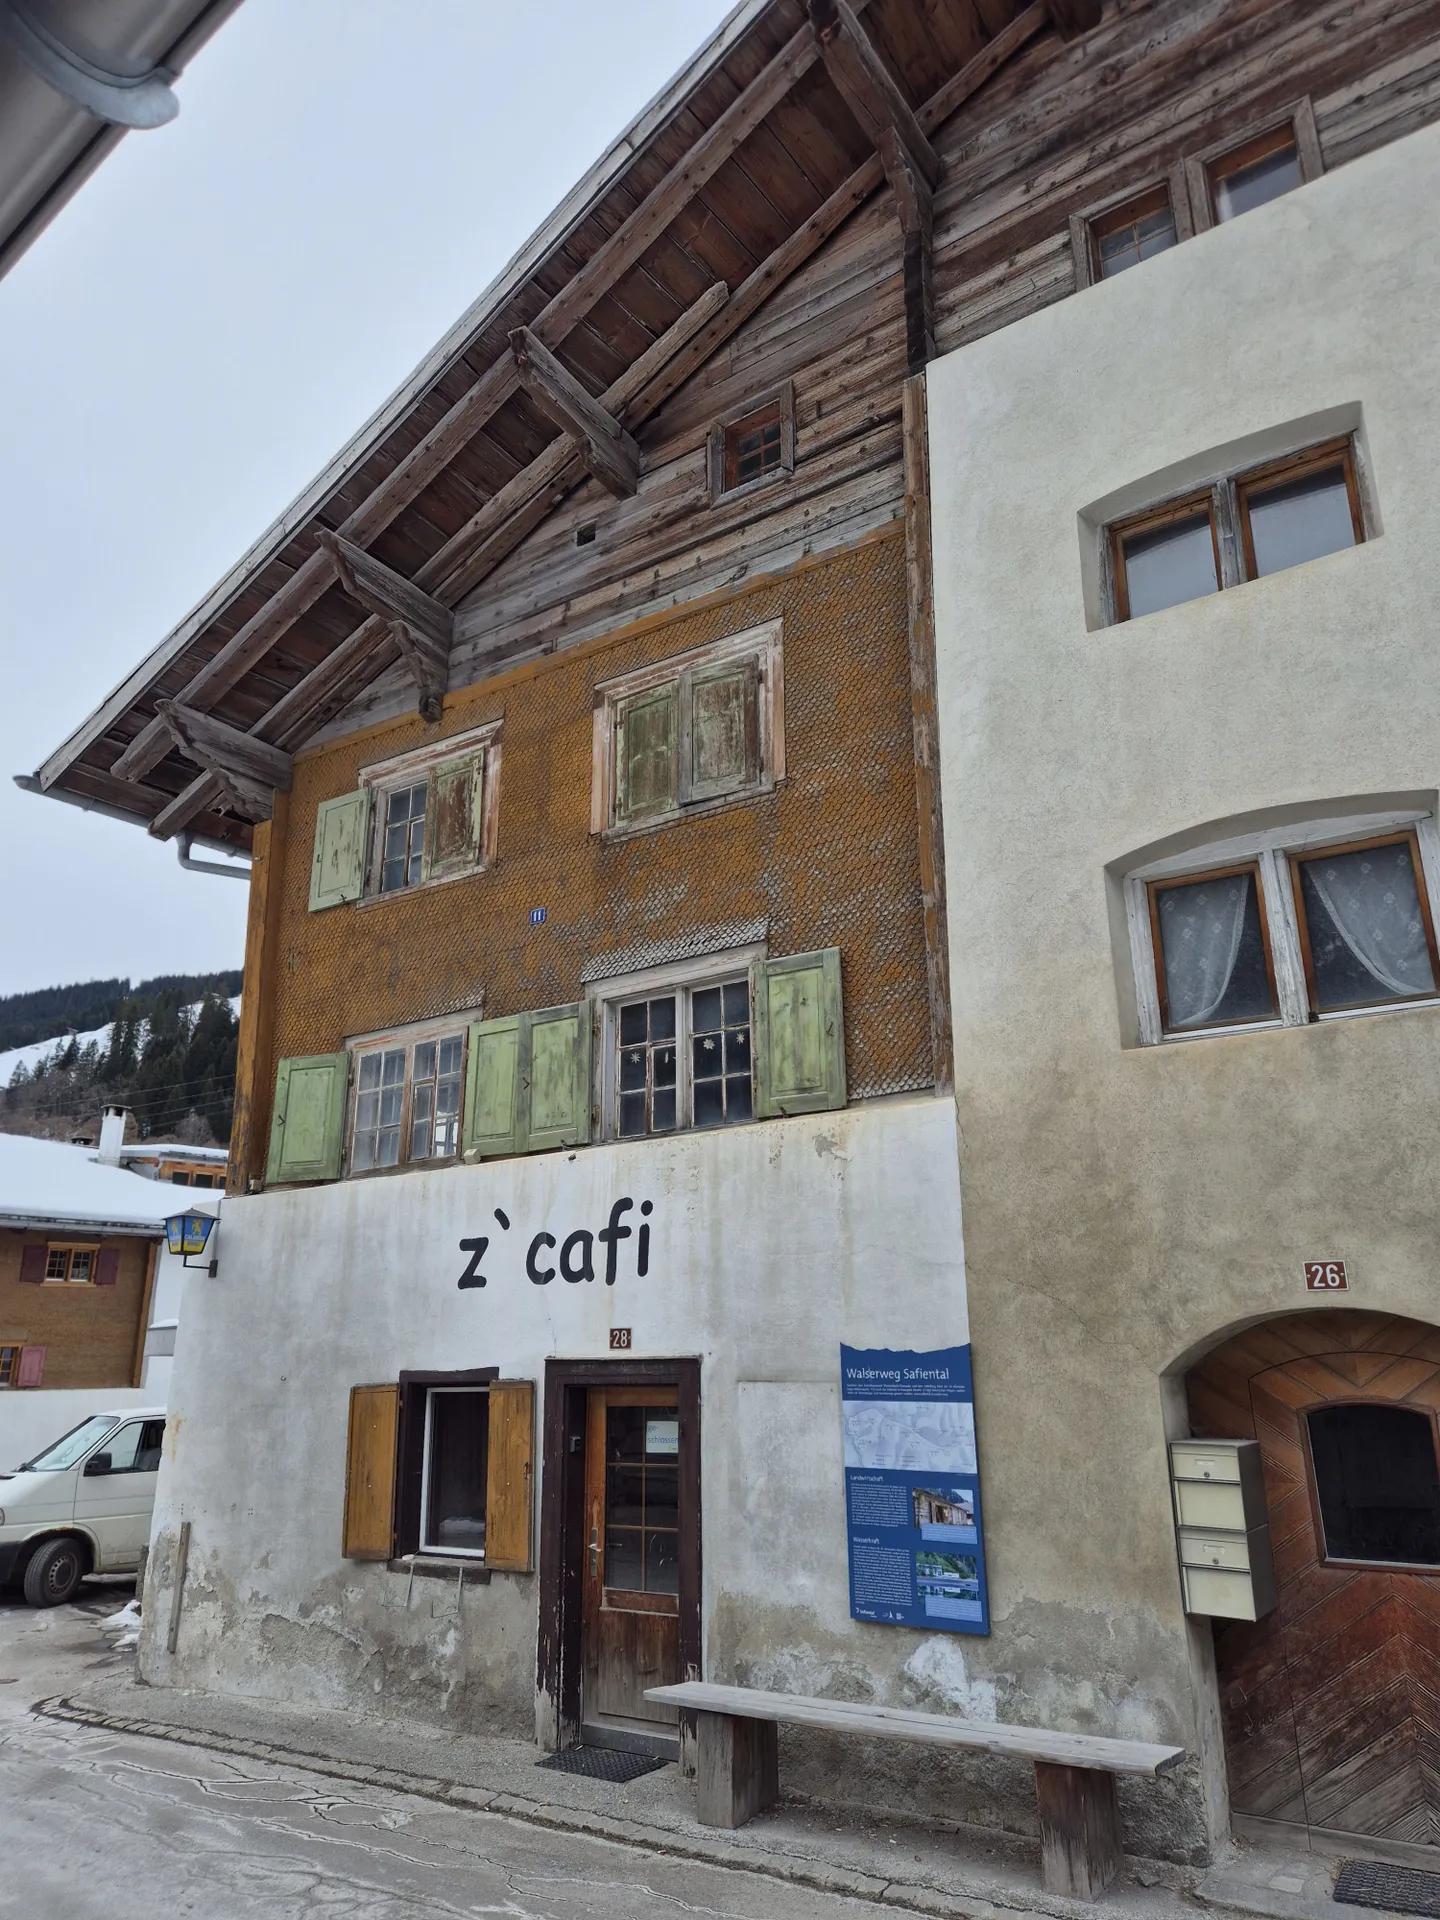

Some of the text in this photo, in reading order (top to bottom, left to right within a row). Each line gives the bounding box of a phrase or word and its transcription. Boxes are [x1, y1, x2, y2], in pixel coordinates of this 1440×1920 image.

[533, 910, 541, 922] 11
[1310, 1264, 1340, 1287] 26
[612, 1330, 628, 1347] 28
[846, 1367, 950, 1382] Walserweg Safiental
